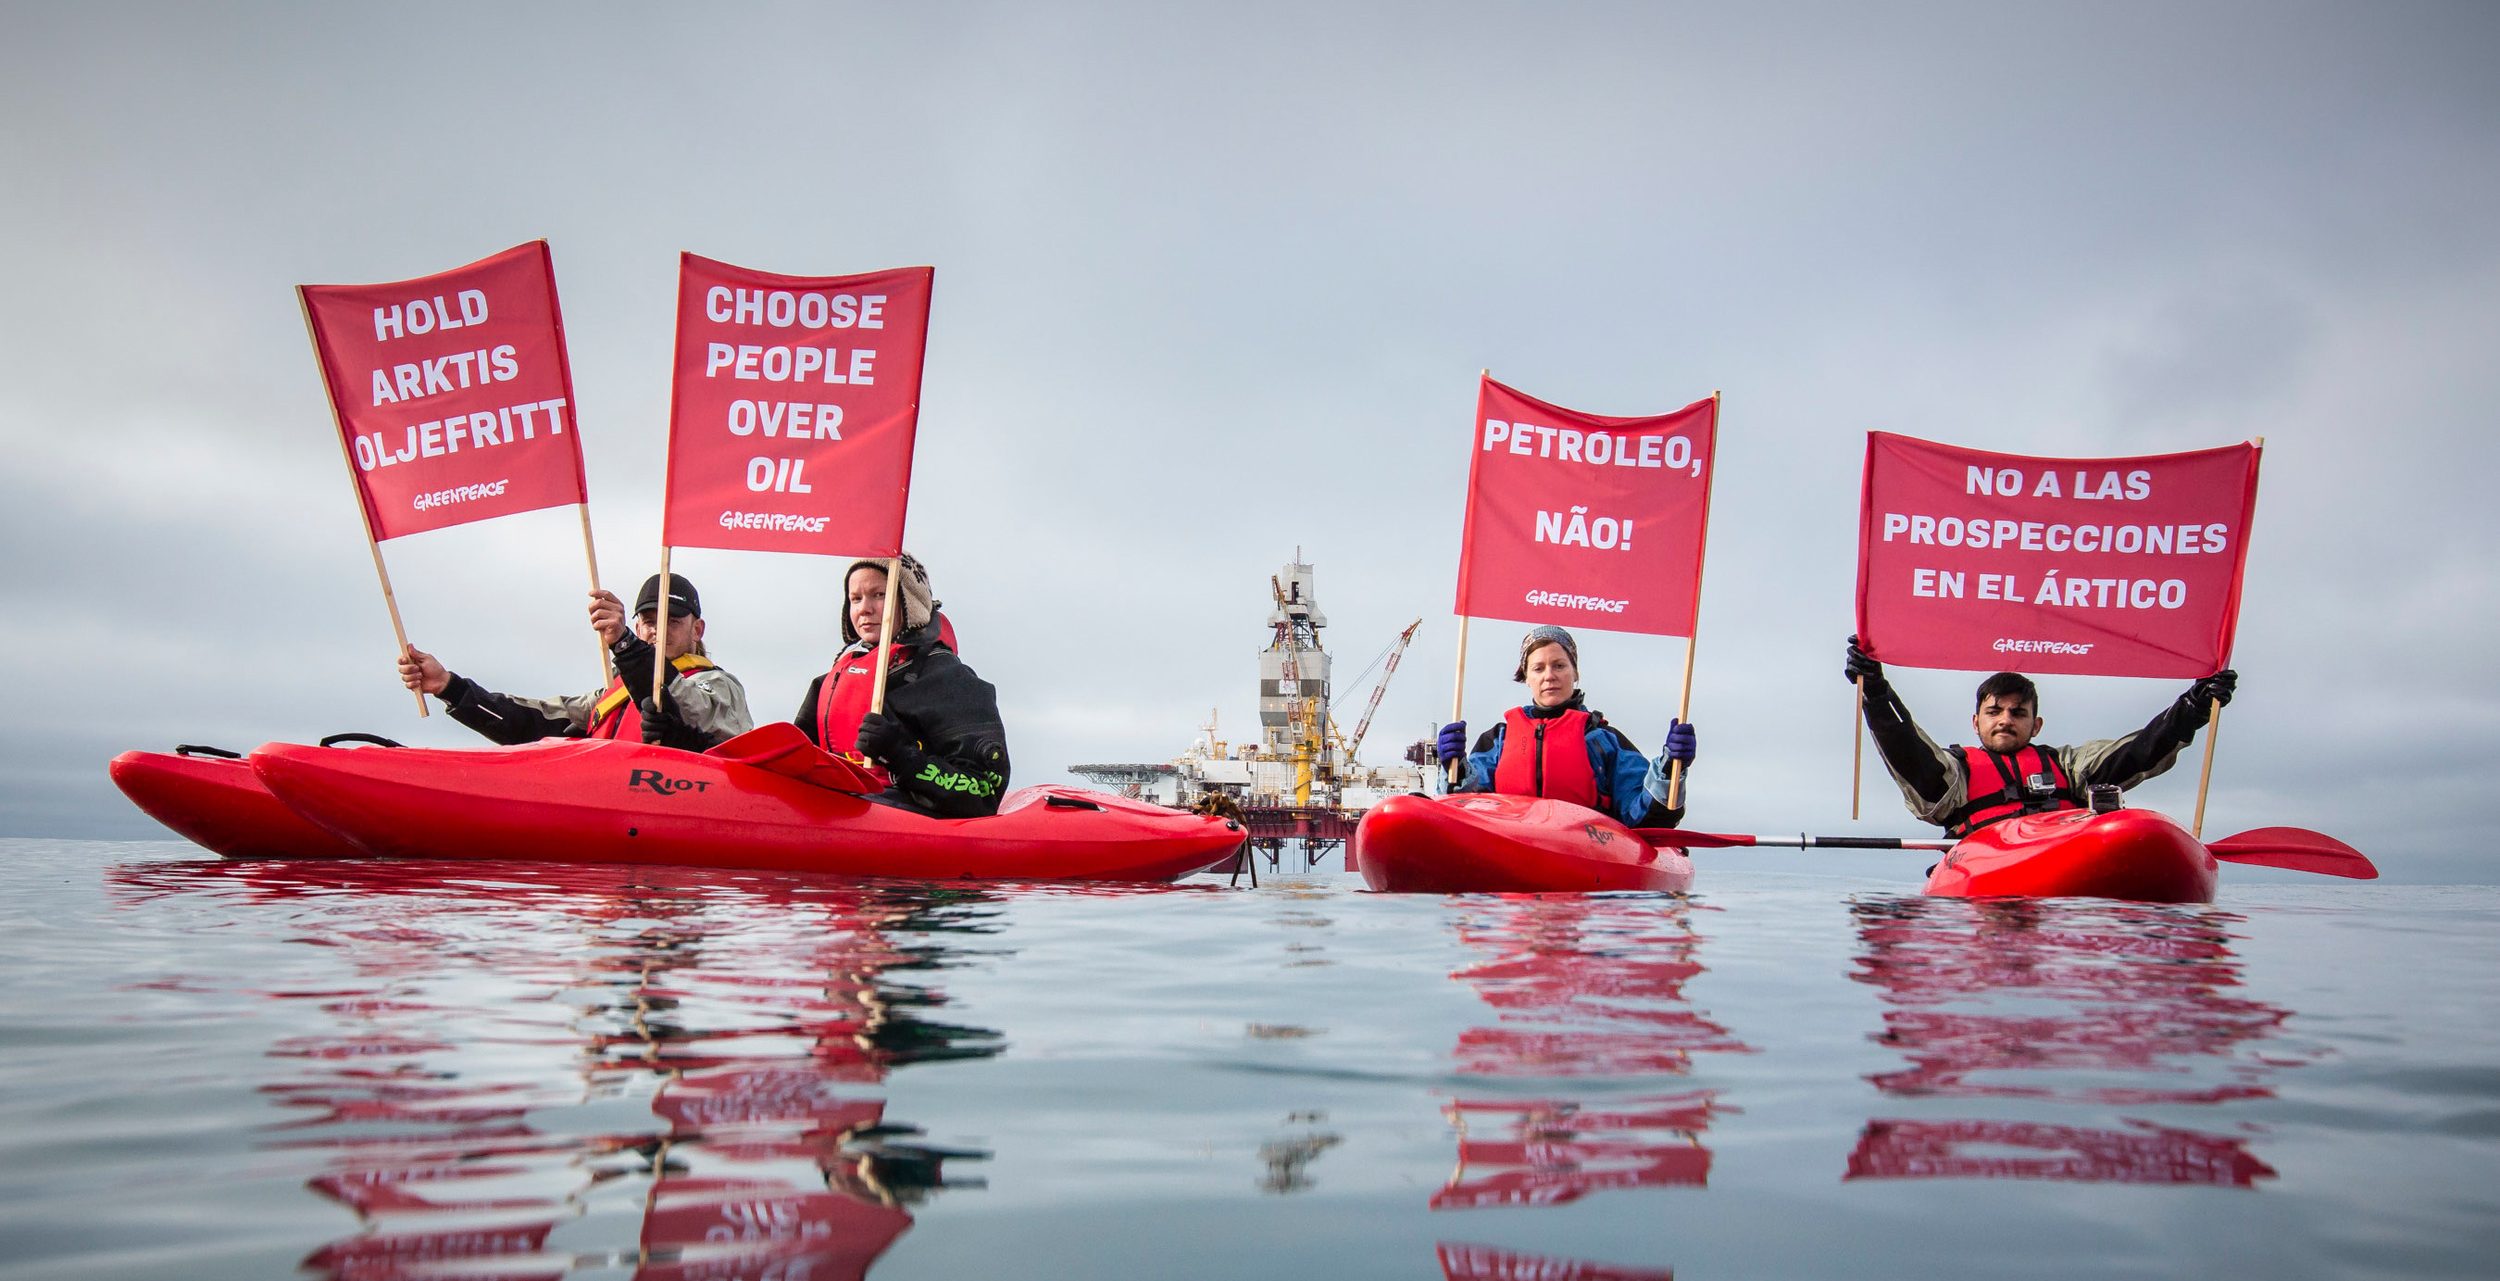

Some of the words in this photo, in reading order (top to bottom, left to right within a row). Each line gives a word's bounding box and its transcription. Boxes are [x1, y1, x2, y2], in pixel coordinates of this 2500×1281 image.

[373, 290, 488, 342] HOLD
[707, 286, 886, 330] CHOOSE
[372, 345, 519, 407] ARKTIS
[706, 343, 877, 386] PEOPLE
[355, 397, 567, 472] OLJEFRITT
[728, 400, 844, 441] OVER
[1483, 419, 1702, 477] PETRÓLEO,
[413, 479, 509, 511] GREENPEACE
[747, 457, 812, 494] OIL
[1967, 465, 2022, 497] NO
[2033, 471, 2061, 498] A
[2074, 471, 2151, 500] LAS
[720, 511, 830, 533] GREENPEACE
[1535, 505, 1633, 551] NÃO!
[1884, 513, 2228, 555] PROSPECCIONES
[1526, 590, 1629, 613] GREENPEACE
[1913, 569, 1965, 599] EN
[1978, 574, 2025, 603] EL
[2034, 569, 2187, 609] ÁRTICO
[1993, 639, 2093, 654] GREENPEACE
[629, 769, 714, 795] RIOT
